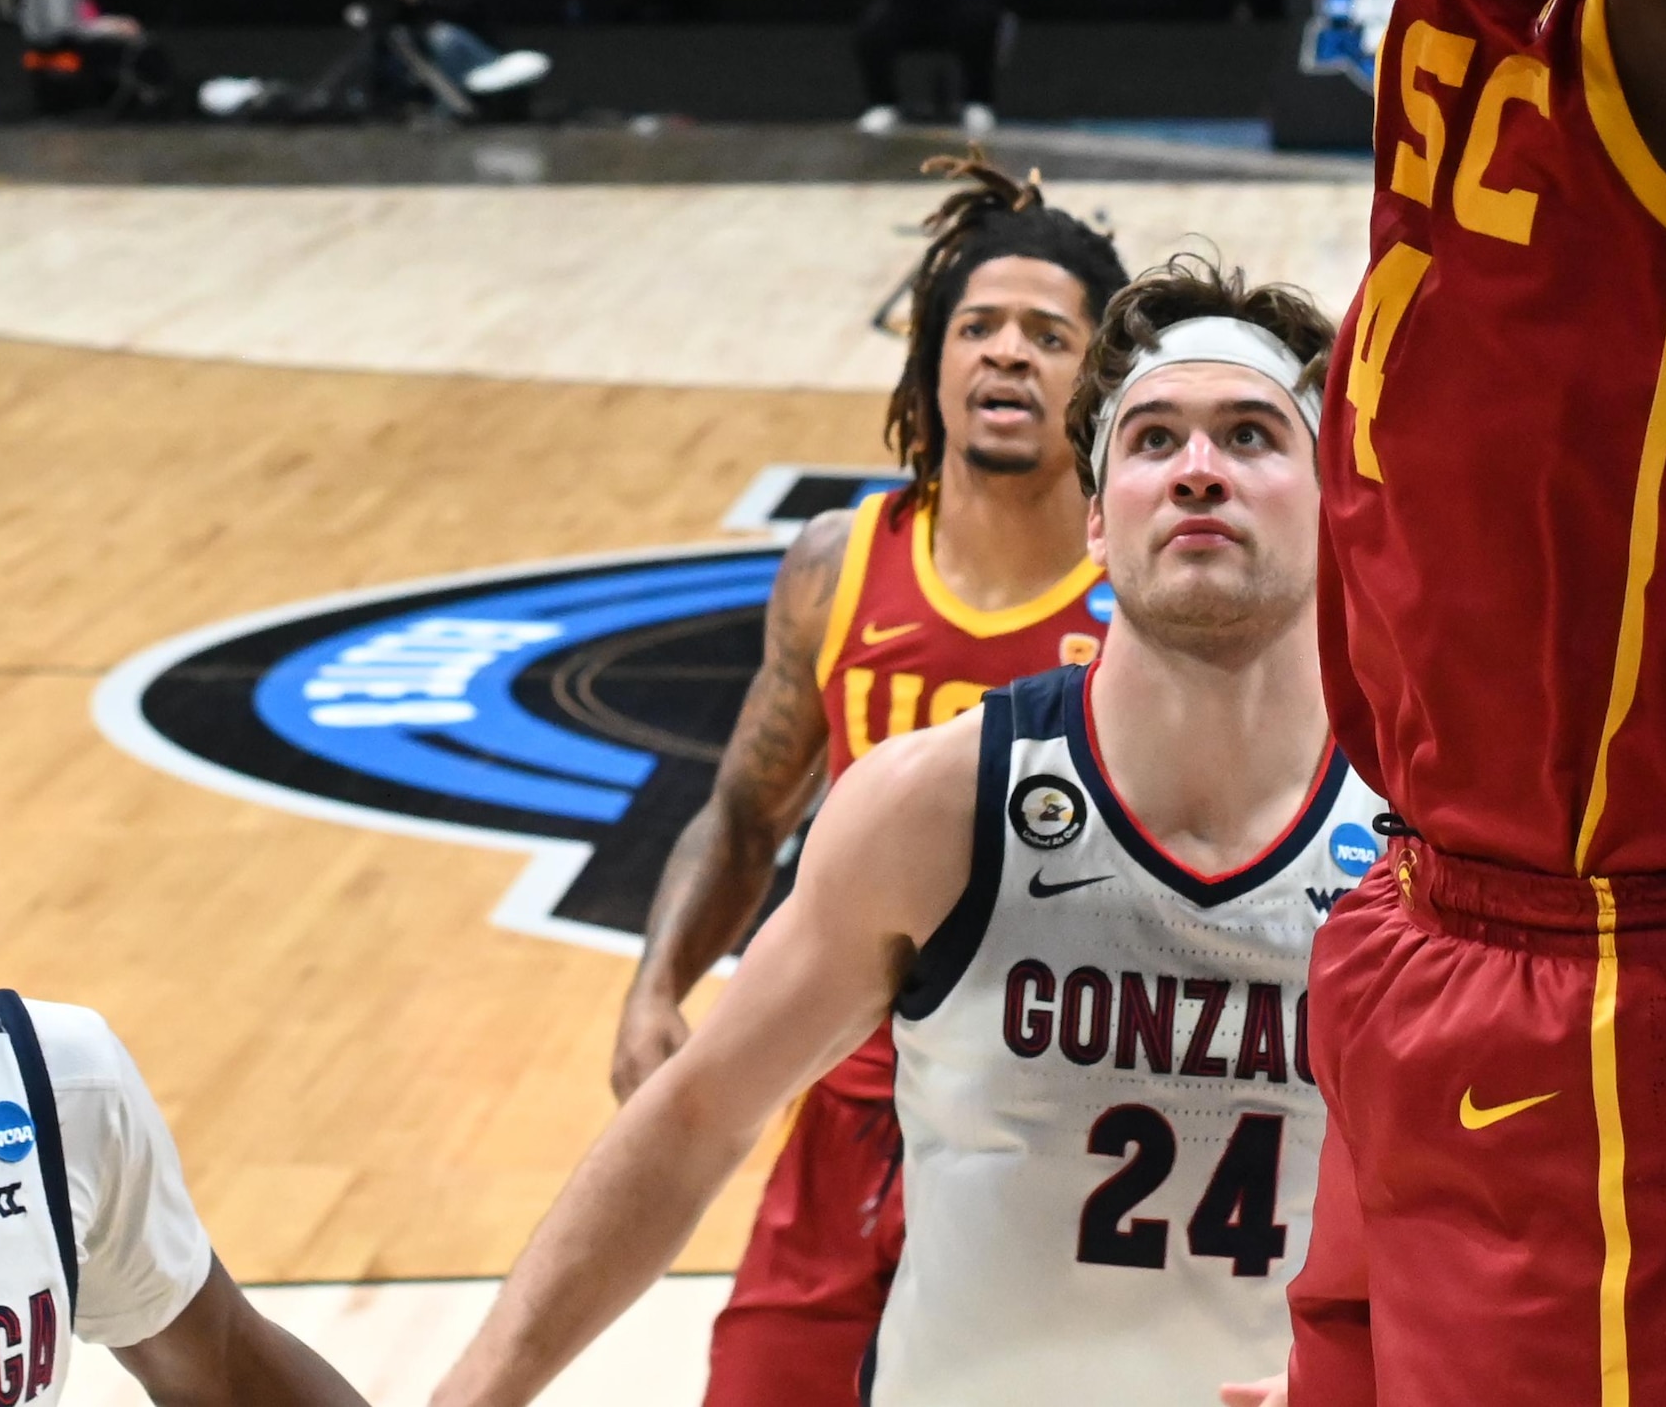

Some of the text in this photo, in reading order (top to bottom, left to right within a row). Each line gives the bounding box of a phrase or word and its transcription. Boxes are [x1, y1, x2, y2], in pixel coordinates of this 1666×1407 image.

[1374, 19, 1550, 247] SC
[1346, 241, 1433, 484] 4
[1337, 845, 1376, 864] NCAA
[1003, 959, 1317, 1086] GONZA
[1077, 1103, 1287, 1277] 24
